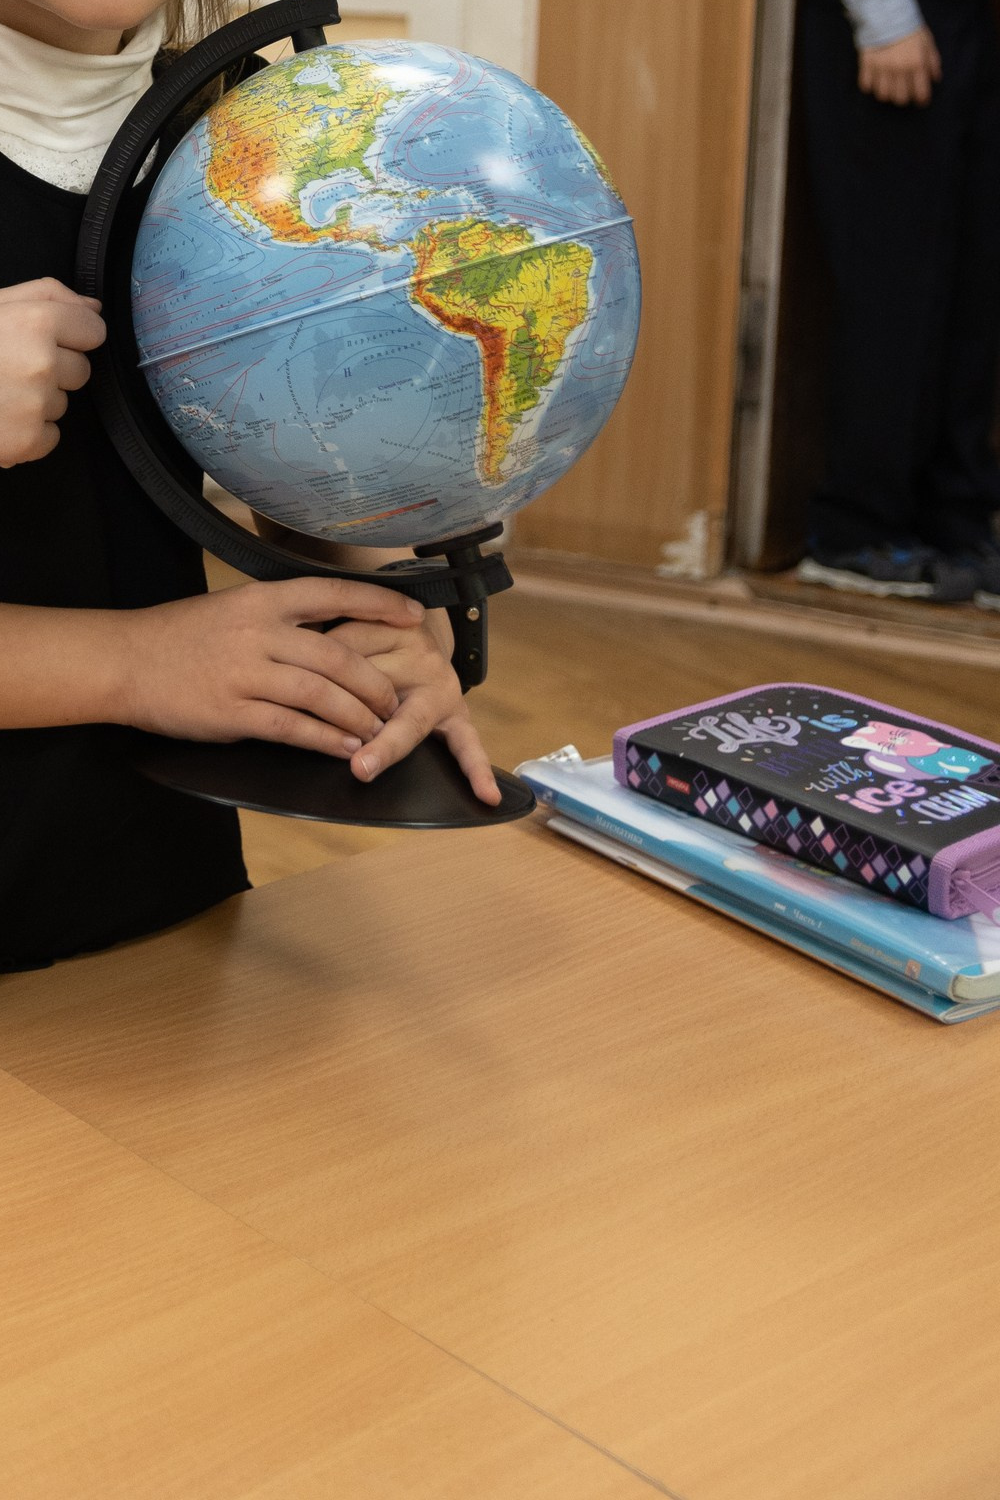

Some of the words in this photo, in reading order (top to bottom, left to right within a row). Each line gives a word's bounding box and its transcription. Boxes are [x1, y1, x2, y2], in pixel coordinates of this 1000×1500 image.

[804, 759, 873, 793] with
[834, 780, 928, 815] ice
[910, 784, 1000, 821] CREAM
